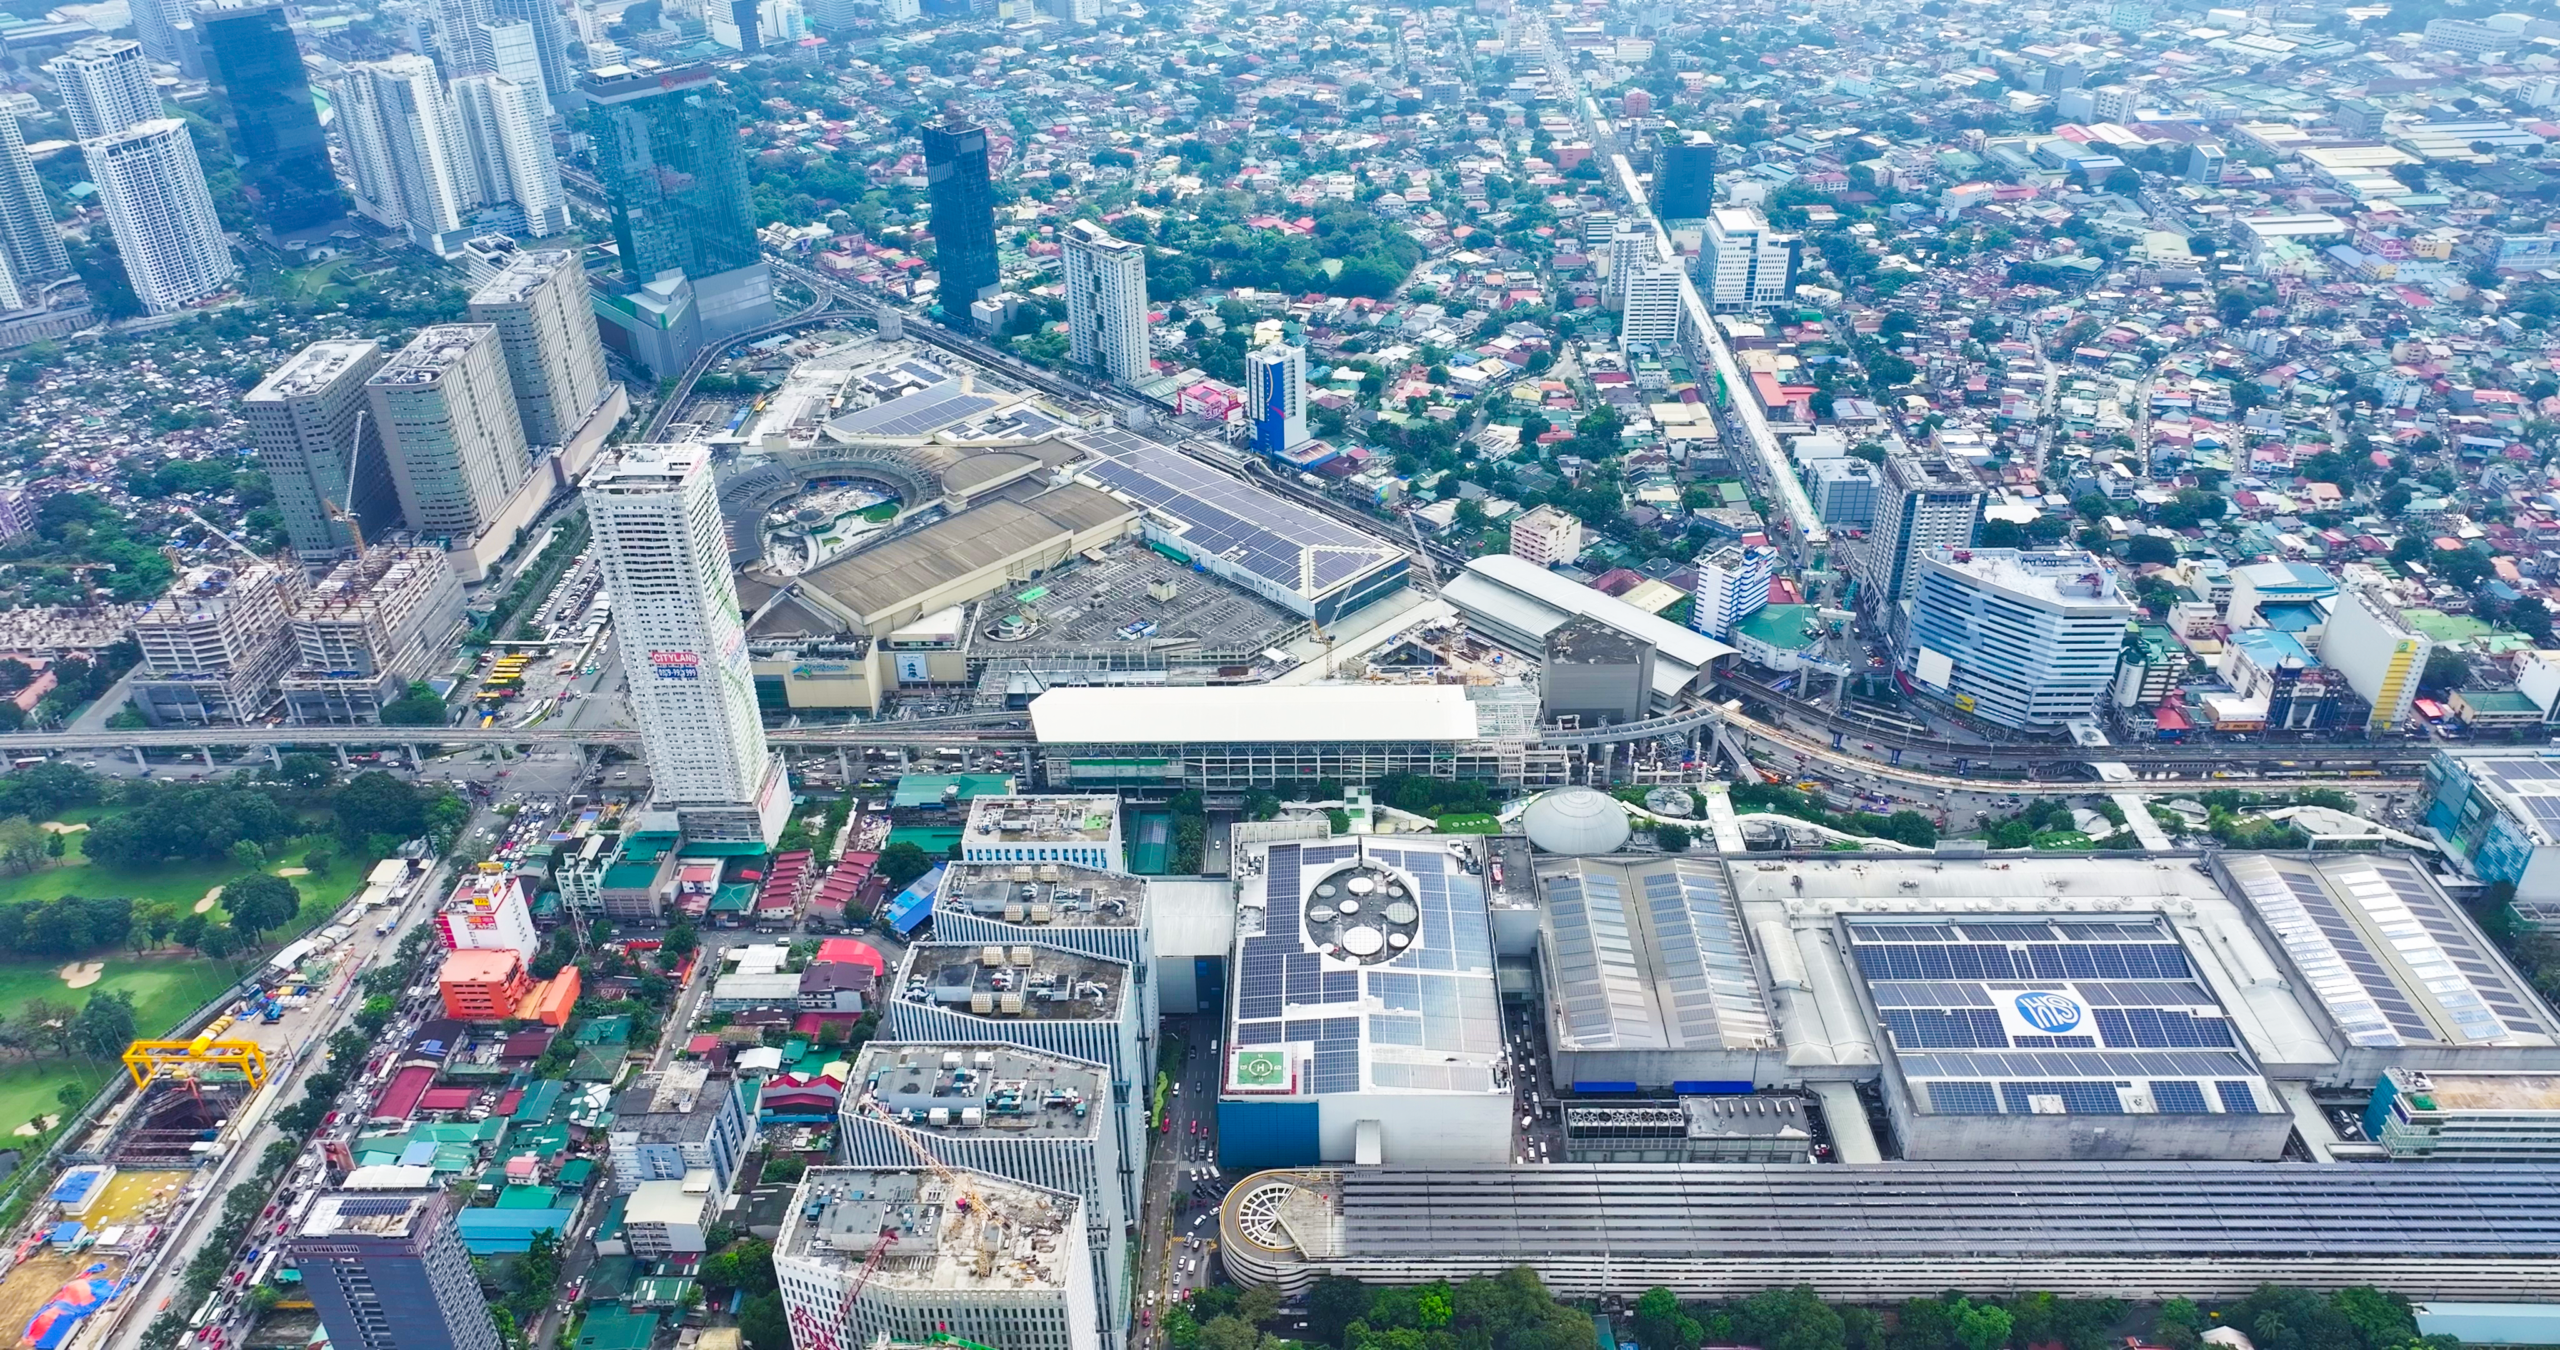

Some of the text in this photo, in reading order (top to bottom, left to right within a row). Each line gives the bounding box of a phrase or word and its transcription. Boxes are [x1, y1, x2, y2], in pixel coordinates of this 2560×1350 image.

[653, 653, 697, 664] CITYLAND
[2018, 994, 2079, 1030] SM
[1257, 1063, 1265, 1072] H
